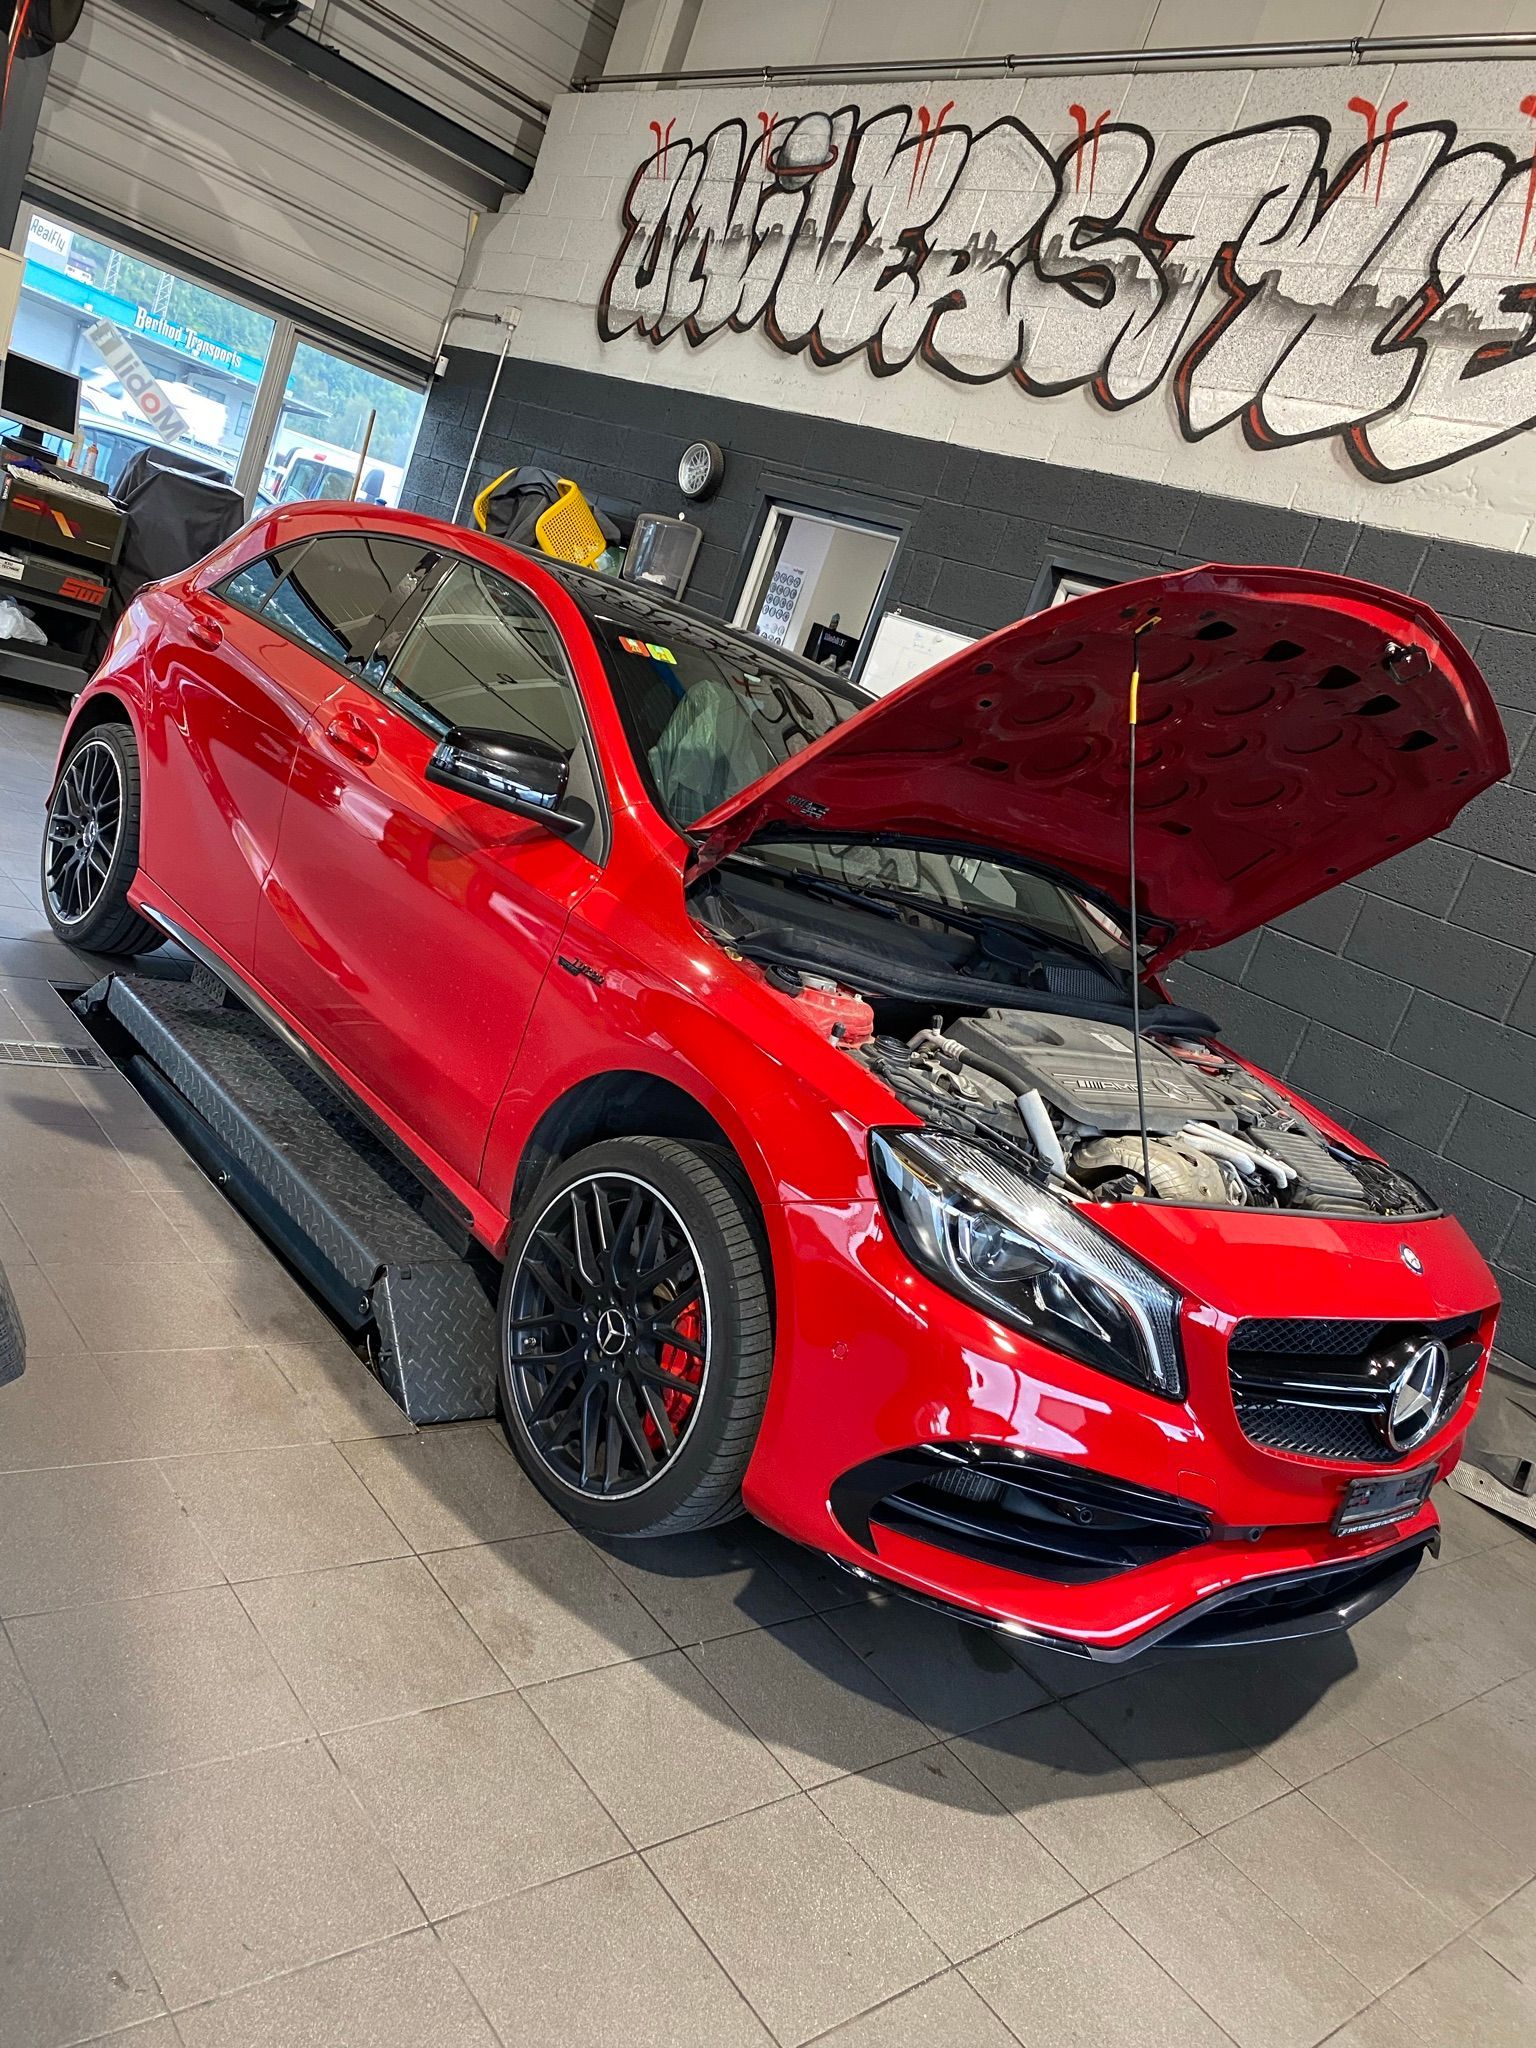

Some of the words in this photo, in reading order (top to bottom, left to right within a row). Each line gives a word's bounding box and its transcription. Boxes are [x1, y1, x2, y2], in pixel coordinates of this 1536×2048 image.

[30, 218, 67, 253] RealFly
[134, 305, 183, 342] Berthod
[184, 326, 243, 368] Transports
